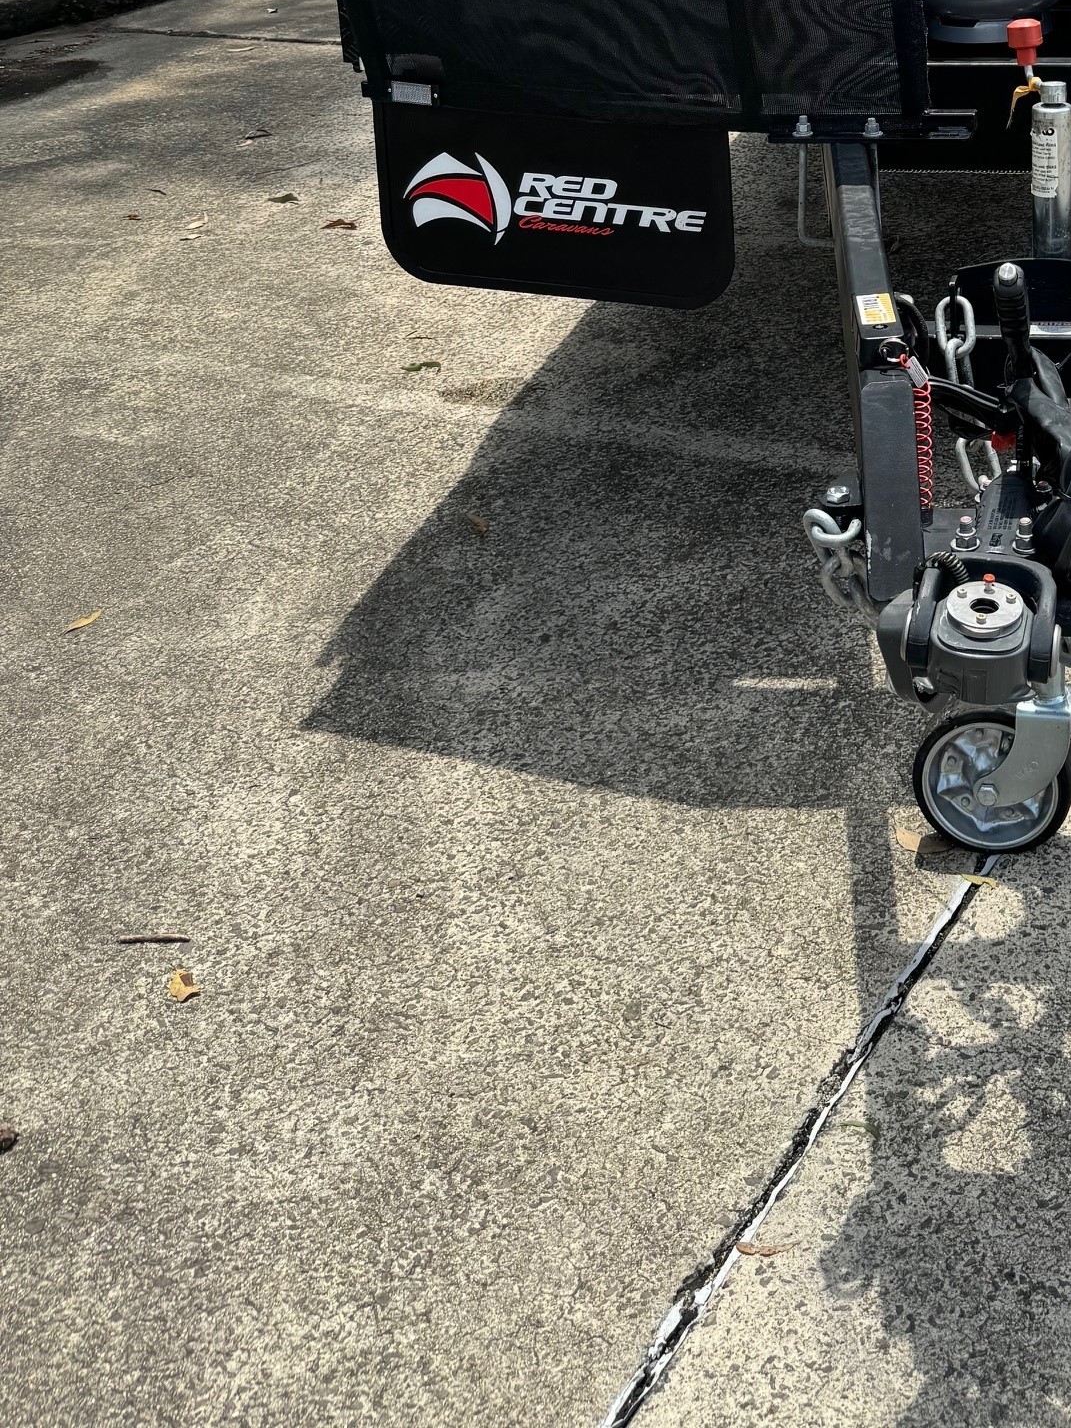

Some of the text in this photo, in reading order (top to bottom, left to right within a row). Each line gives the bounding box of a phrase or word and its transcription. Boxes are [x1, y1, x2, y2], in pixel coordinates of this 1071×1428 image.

[518, 172, 618, 200] RED
[513, 196, 707, 233] CENTRE
[518, 215, 615, 235] Caravans
